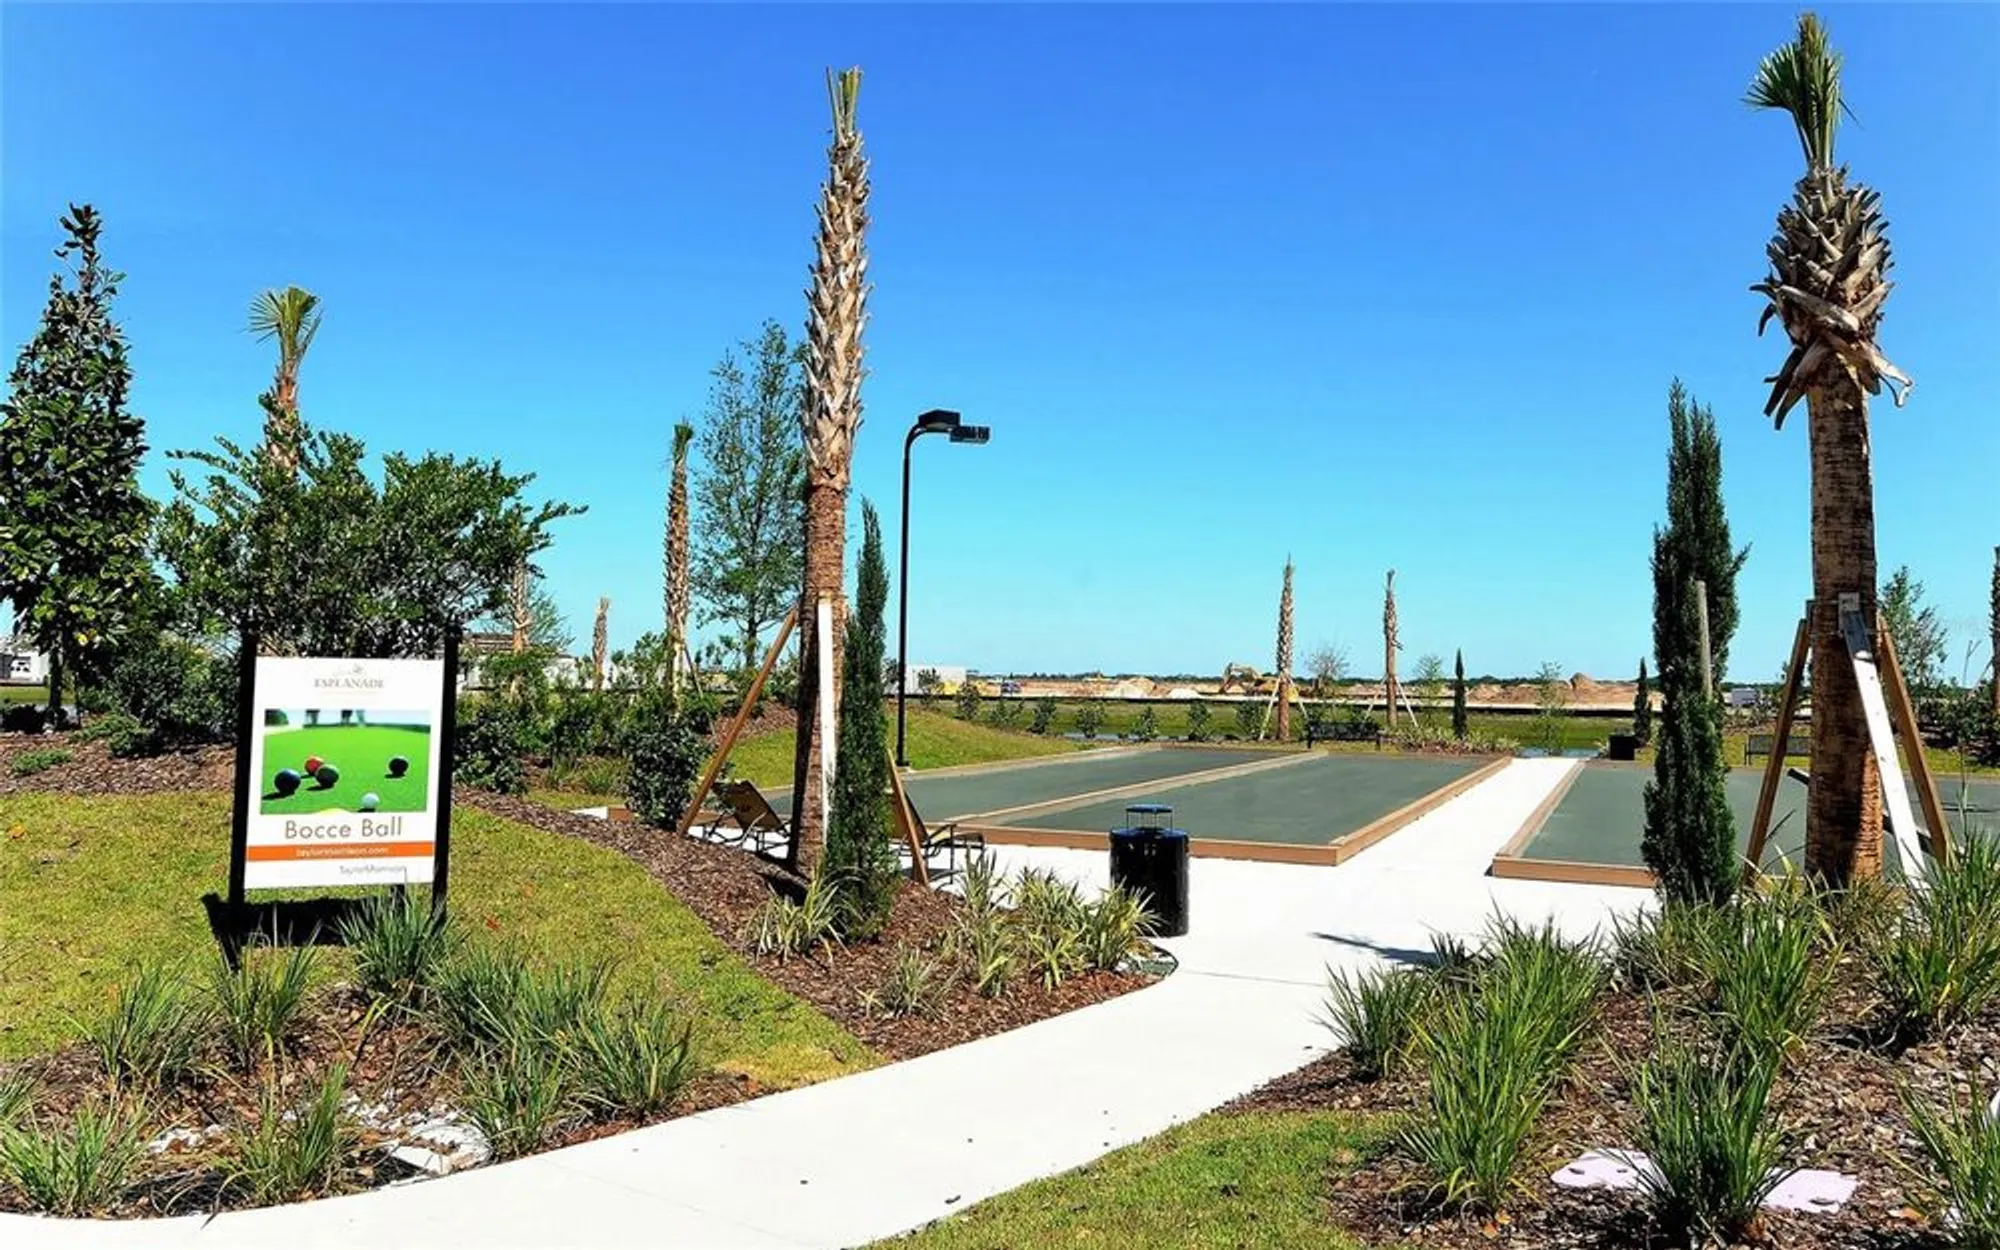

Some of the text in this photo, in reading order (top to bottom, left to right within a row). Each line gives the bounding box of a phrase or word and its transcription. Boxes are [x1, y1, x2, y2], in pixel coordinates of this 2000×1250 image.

[314, 678, 384, 688] ESPLANADE
[285, 816, 402, 839] Bocce Ball
